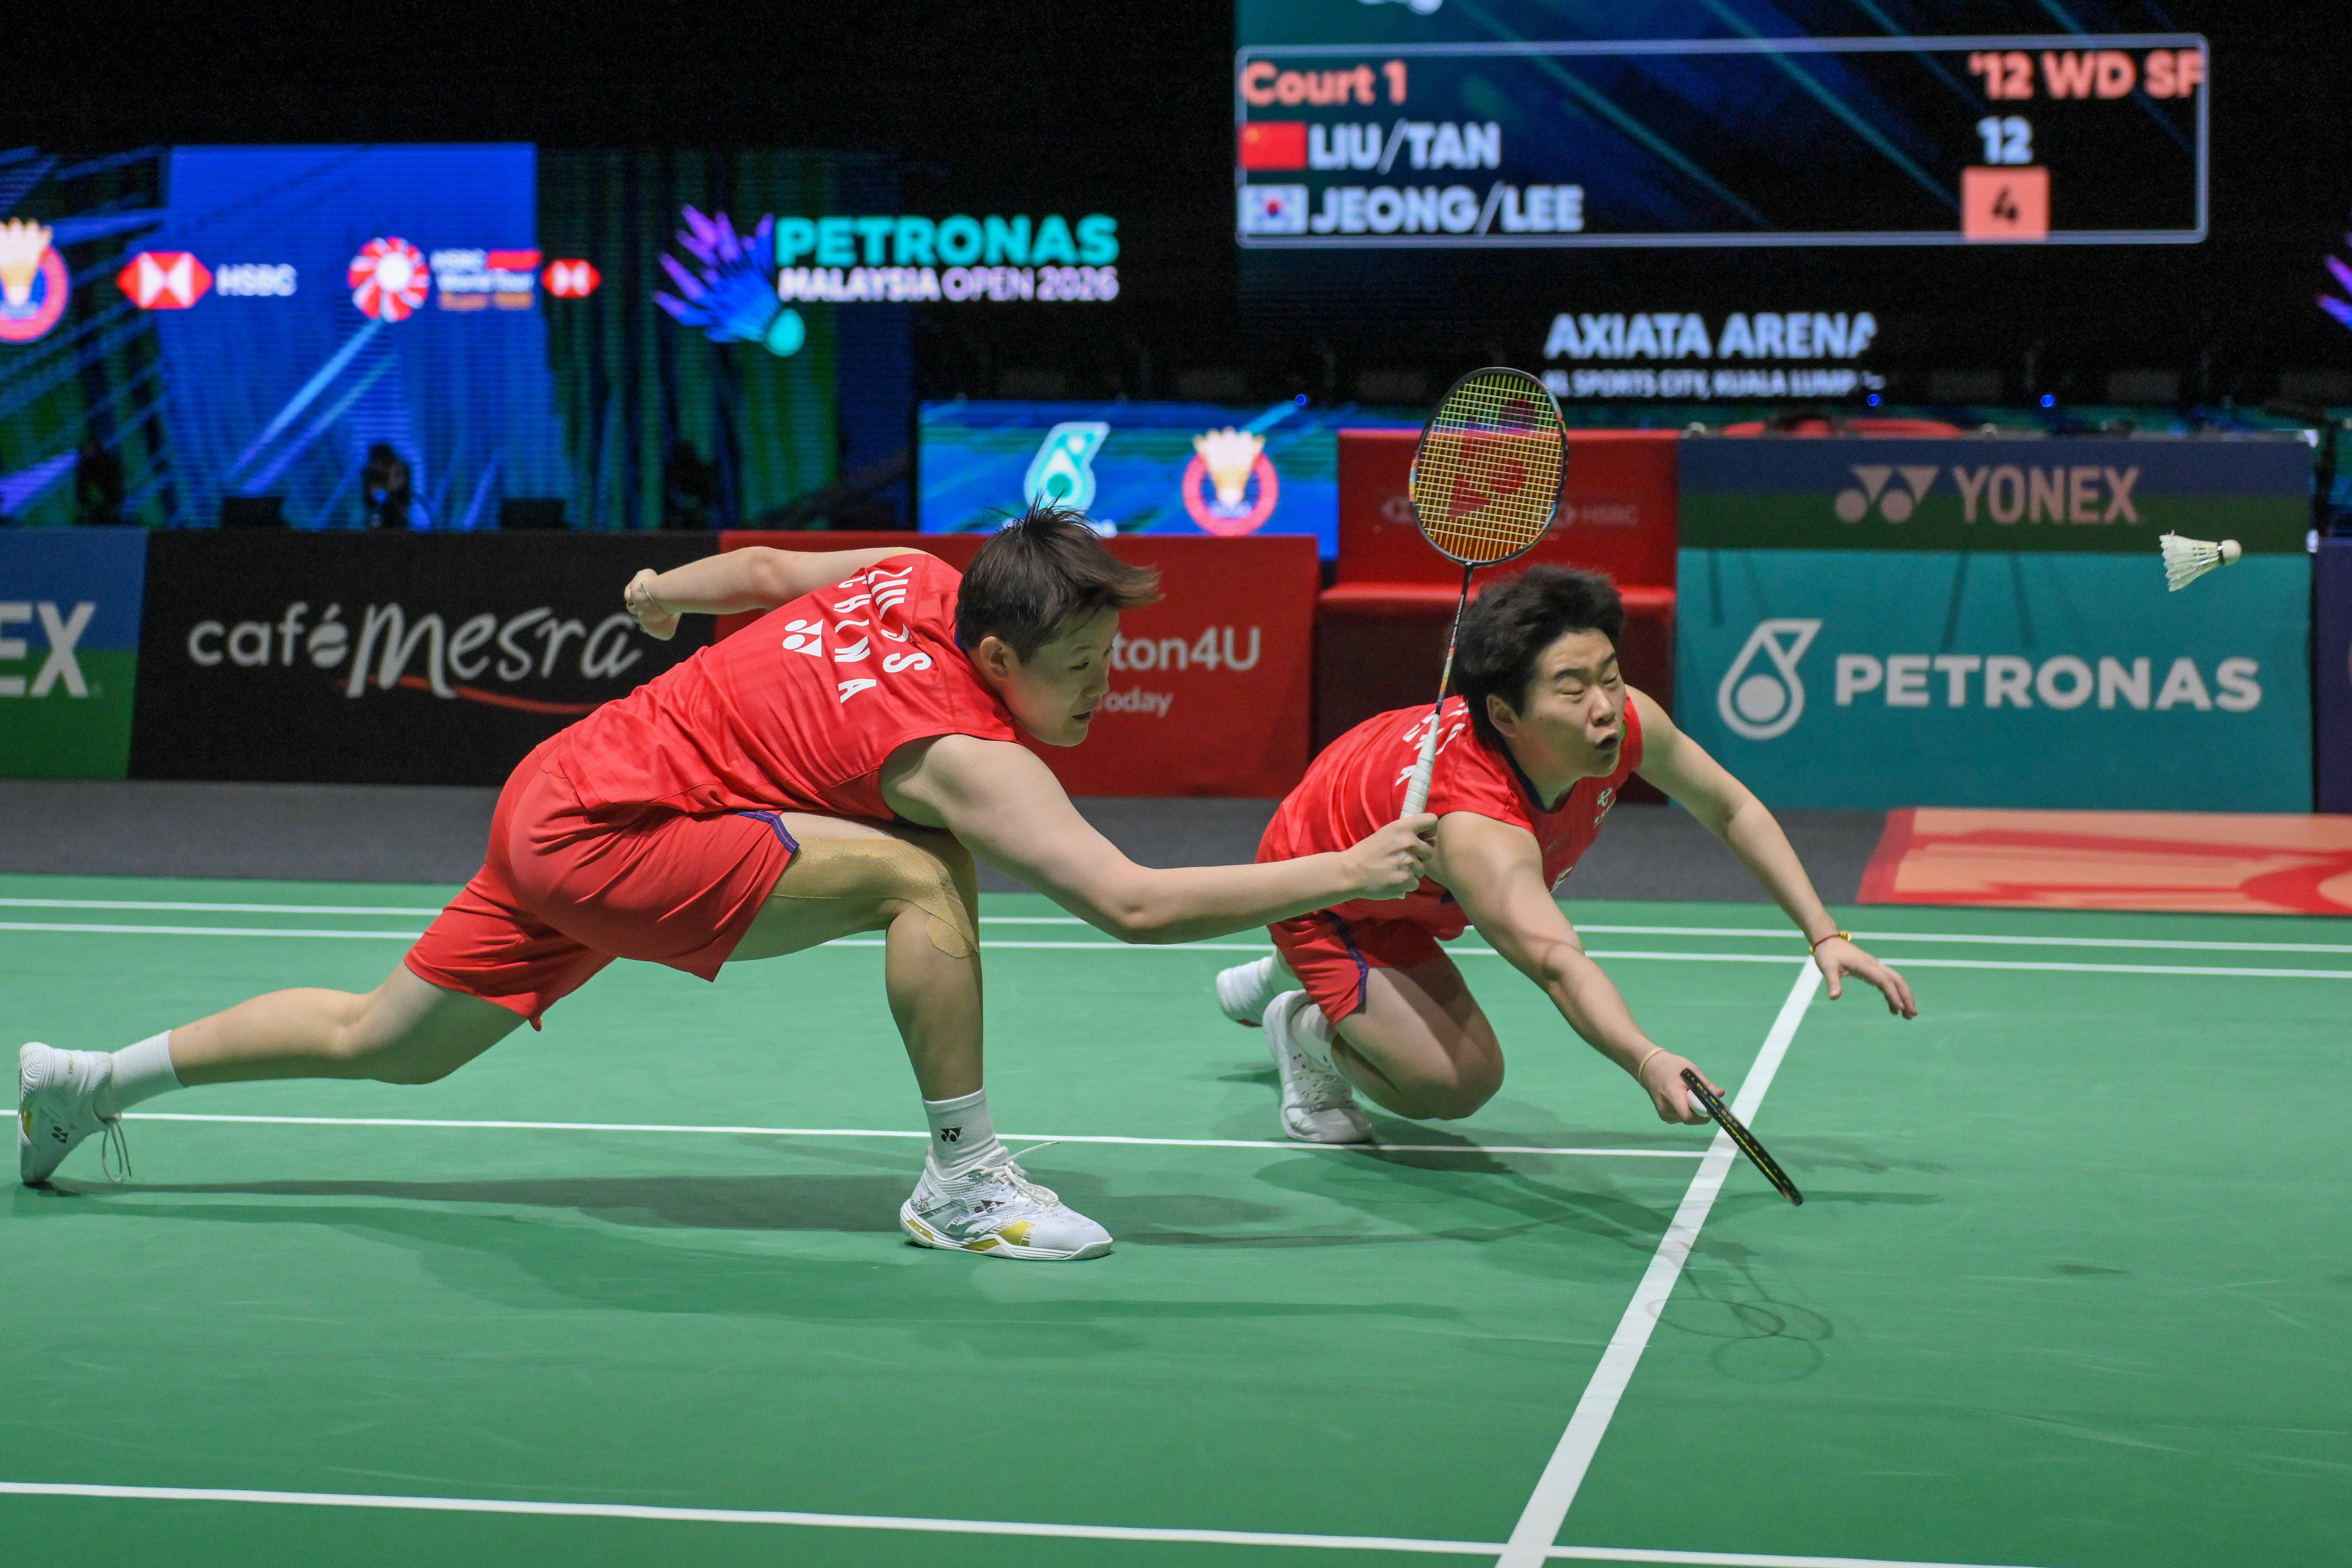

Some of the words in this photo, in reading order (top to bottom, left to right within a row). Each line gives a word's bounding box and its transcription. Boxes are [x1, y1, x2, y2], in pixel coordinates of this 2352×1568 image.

[1239, 61, 1375, 106] Court
[1383, 59, 1408, 105] 1
[2041, 50, 2137, 99] WD
[2143, 49, 2203, 98] SF
[1308, 118, 1501, 174] LIU/TAN
[1976, 115, 2034, 165] 12
[1310, 181, 1585, 237] JEONG/LEE
[1991, 186, 2019, 223] 4
[775, 214, 1120, 266] PETRONAS
[216, 263, 298, 297] HSBC
[778, 267, 942, 301] MALAYSIA
[941, 267, 1035, 301] OPEN
[1036, 266, 1120, 301] 2026
[1544, 312, 1712, 359] AXIATA
[1571, 369, 1656, 397] SPORTS
[1952, 465, 2141, 524] YONEX
[1095, 686, 1174, 719] oday
[1836, 654, 2263, 712] PETRONAS
